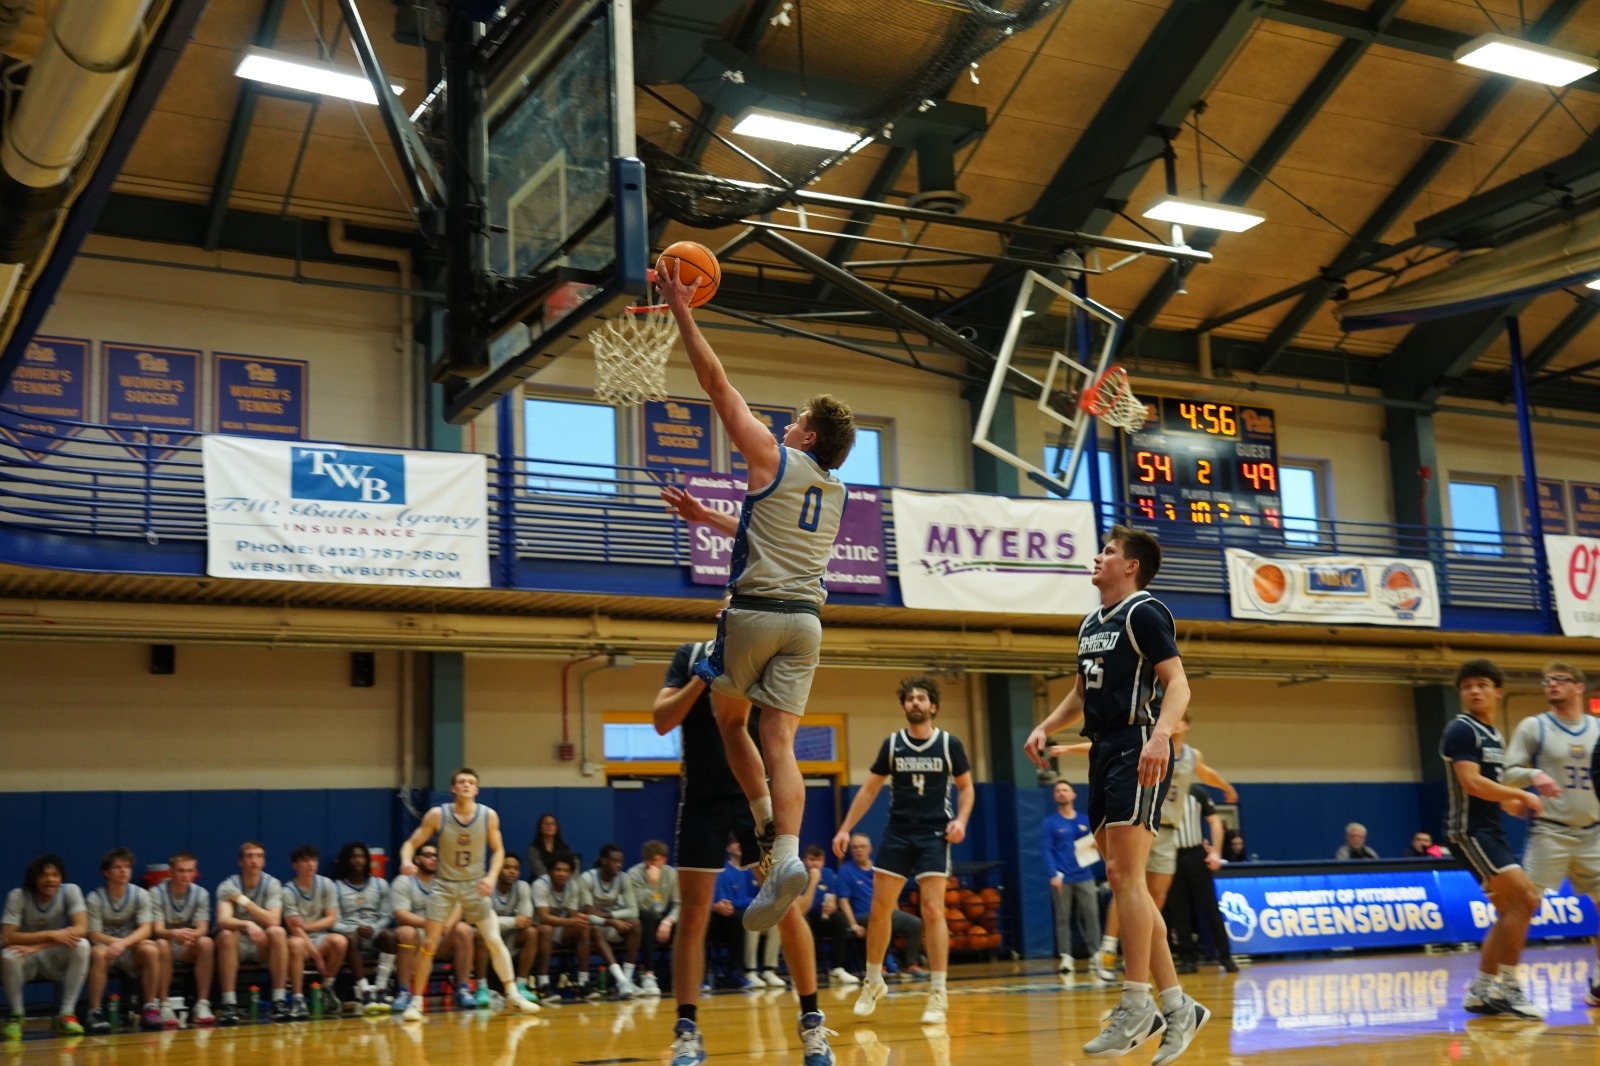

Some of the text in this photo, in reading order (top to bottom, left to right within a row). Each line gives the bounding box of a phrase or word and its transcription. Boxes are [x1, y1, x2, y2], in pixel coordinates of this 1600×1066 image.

[118, 374, 185, 392] WOMEN'S
[229, 384, 292, 402] WOMEN'S
[124, 389, 179, 406] SOCCER
[237, 399, 284, 415] TENNIS
[1180, 402, 1236, 436] 4:56
[652, 422, 703, 438] WOMEN'S
[657, 435, 700, 449] SOCCER
[1235, 443, 1272, 459] GUEST
[300, 449, 392, 503] TWB
[1136, 452, 1172, 483] 54
[1197, 460, 1212, 484] 2
[1242, 462, 1277, 491] 49
[289, 503, 370, 520] Butts
[376, 507, 480, 530] Agency
[798, 485, 823, 533] 0
[283, 523, 416, 538] INSURANCE
[318, 545, 366, 558] (412)
[371, 548, 459, 561] 787-7800
[926, 525, 1077, 560] MYERS
[229, 561, 462, 580] WEBSITE: TWBUTTS.COM
[912, 773, 925, 796] 4
[1264, 886, 1428, 907] UNIVERSITY OF PITTSBURGH
[1259, 901, 1444, 939] GREENSBURG
